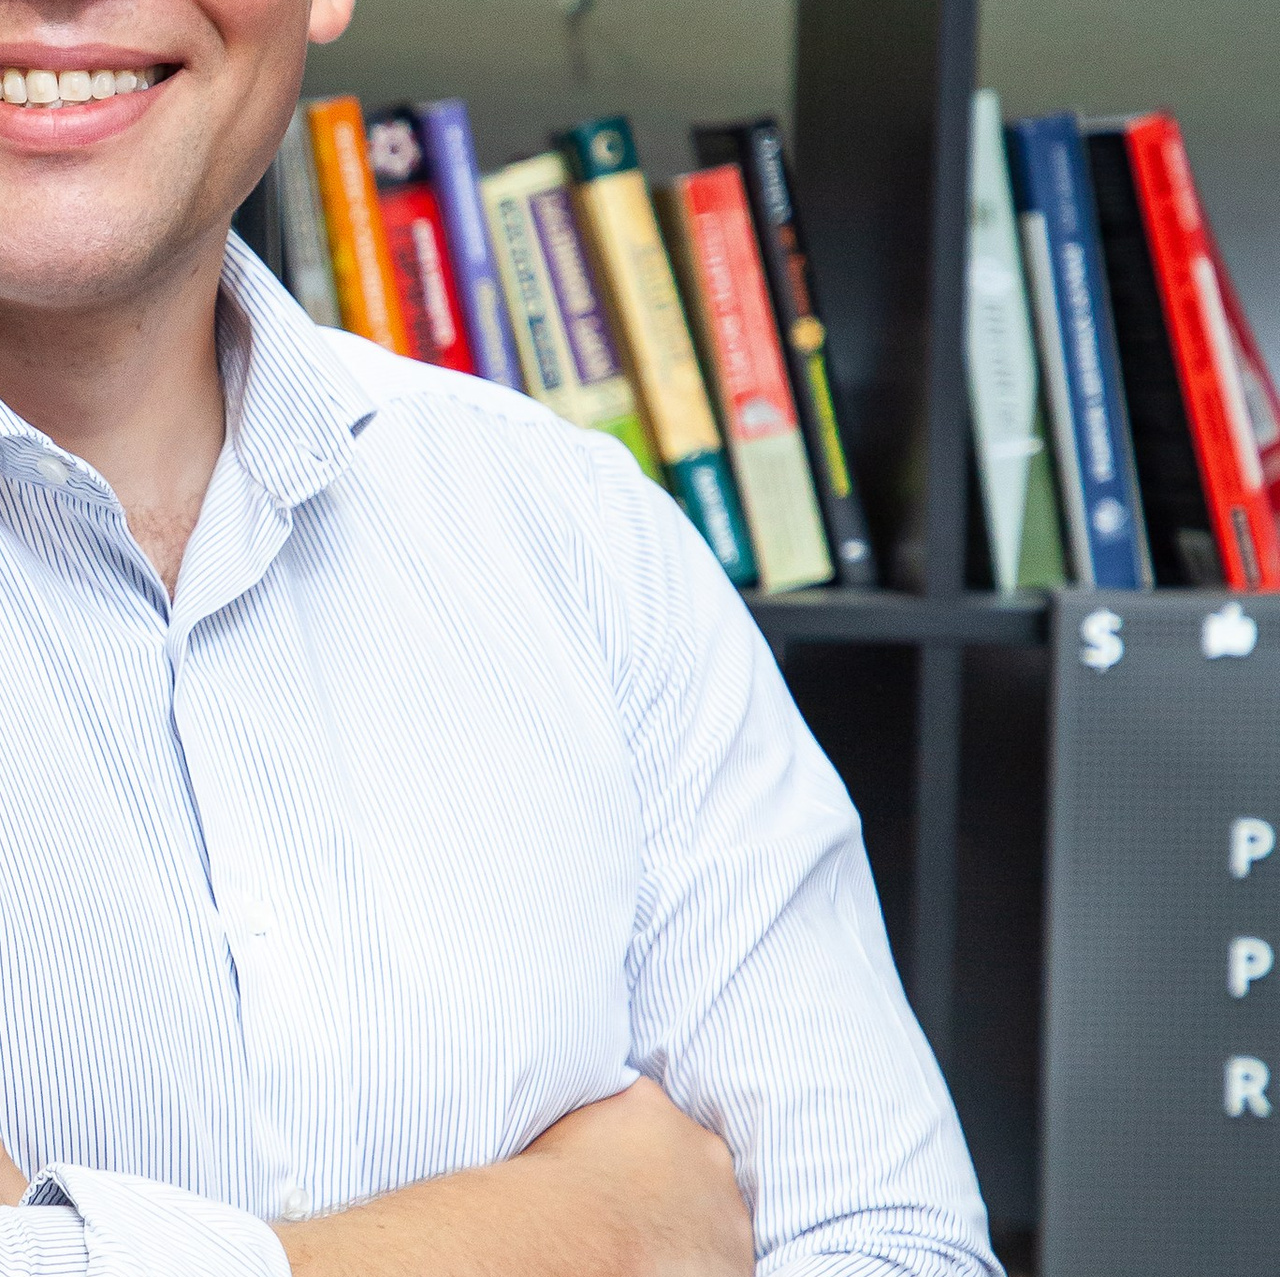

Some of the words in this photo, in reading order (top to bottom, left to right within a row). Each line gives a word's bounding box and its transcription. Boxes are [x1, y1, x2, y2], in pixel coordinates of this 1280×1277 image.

[1230, 817, 1276, 879] P
[1228, 936, 1274, 999] P
[1224, 1055, 1271, 1118] R
